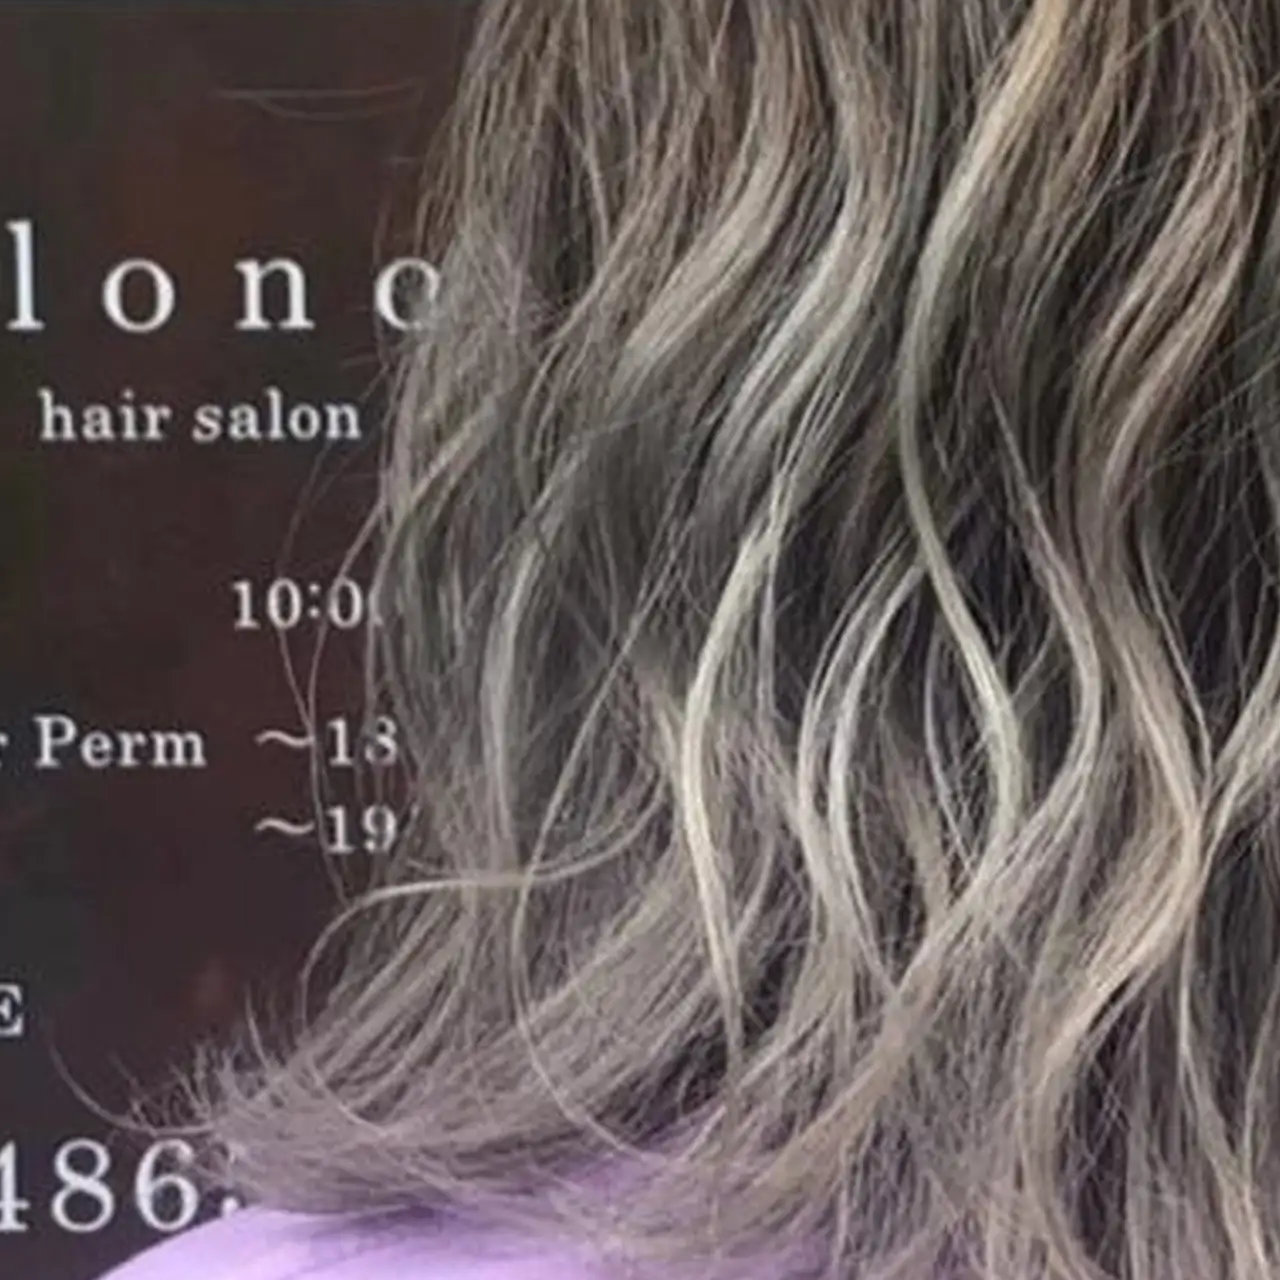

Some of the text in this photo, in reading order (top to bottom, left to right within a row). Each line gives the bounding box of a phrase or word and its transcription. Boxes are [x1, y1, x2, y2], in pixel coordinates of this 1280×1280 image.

[39, 387, 361, 442] hair salon
[232, 577, 382, 629] 10:0
[35, 715, 206, 768] Perm
